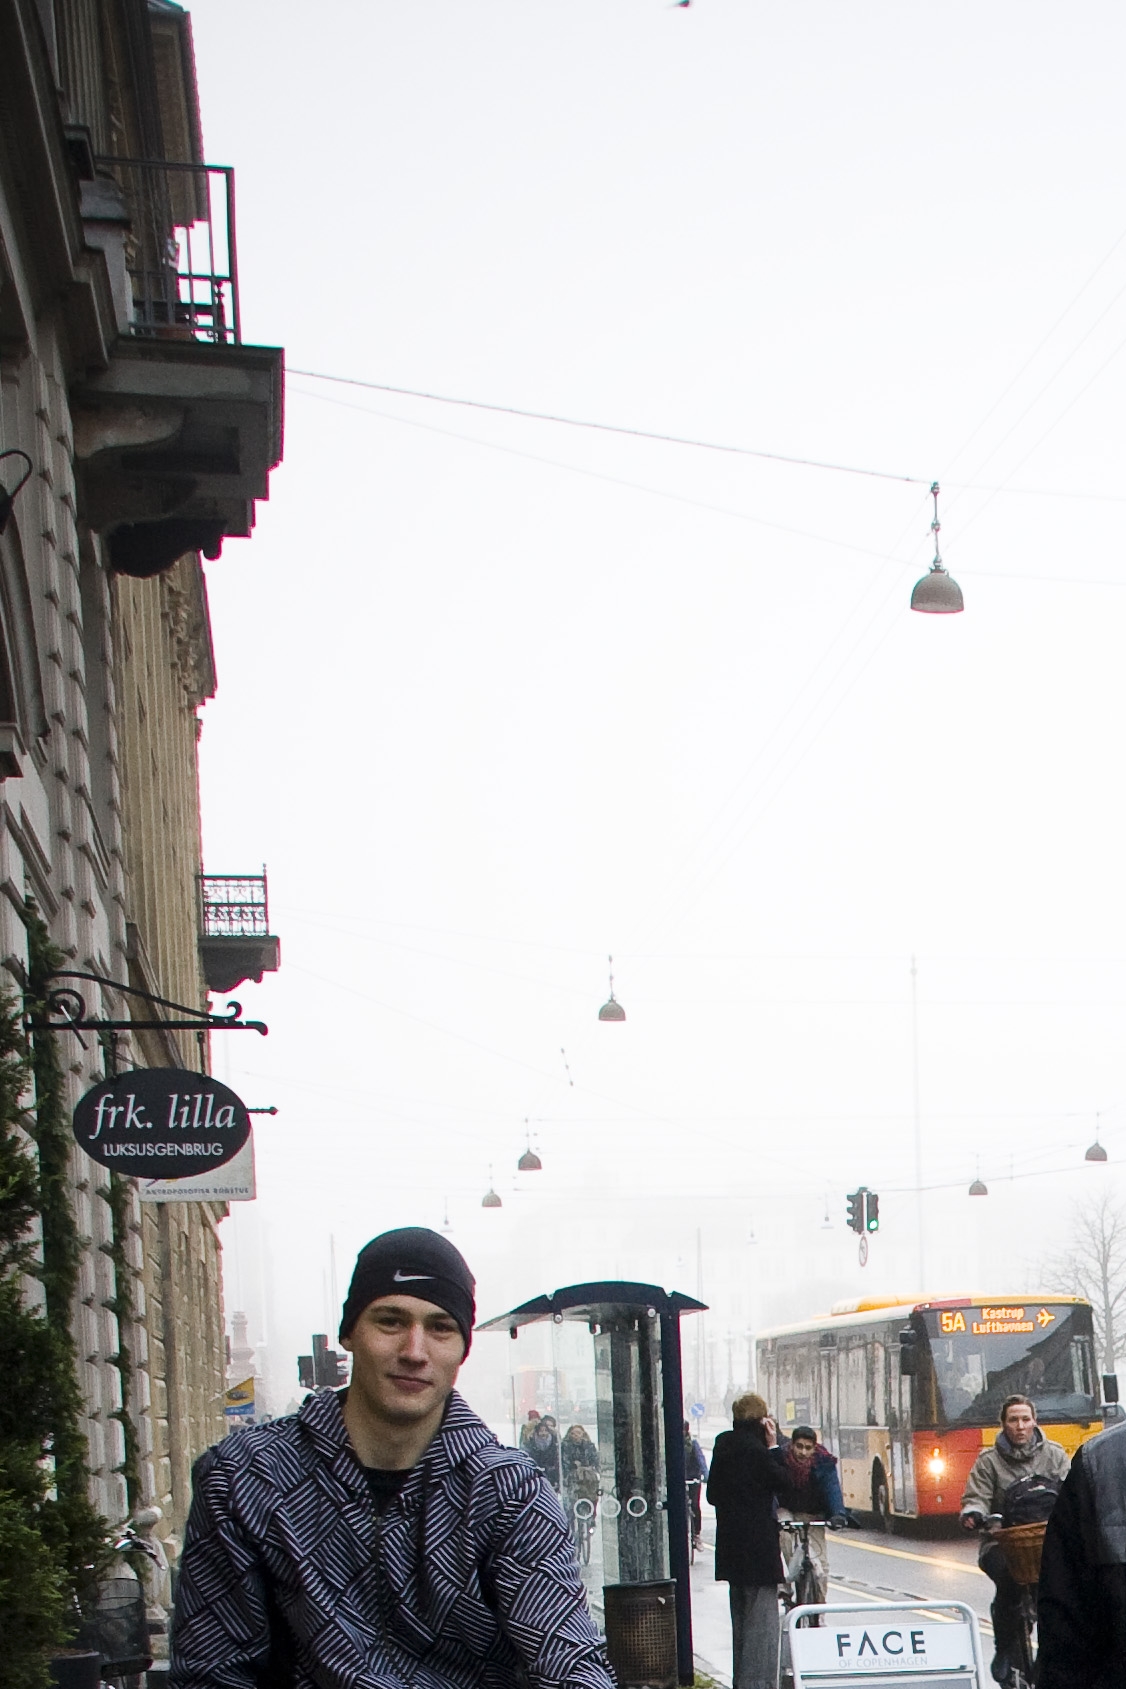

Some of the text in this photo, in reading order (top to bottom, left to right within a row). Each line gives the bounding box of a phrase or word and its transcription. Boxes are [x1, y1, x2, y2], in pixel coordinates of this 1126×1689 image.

[88, 1093, 236, 1140] frk. lilla
[103, 1142, 224, 1157] LUKSUSGENBRUG
[941, 1311, 966, 1332] 5A
[981, 1307, 1025, 1321] Kastrup
[836, 1630, 926, 1657] FACE
[838, 1656, 928, 1668] OF COPENHAGEN
